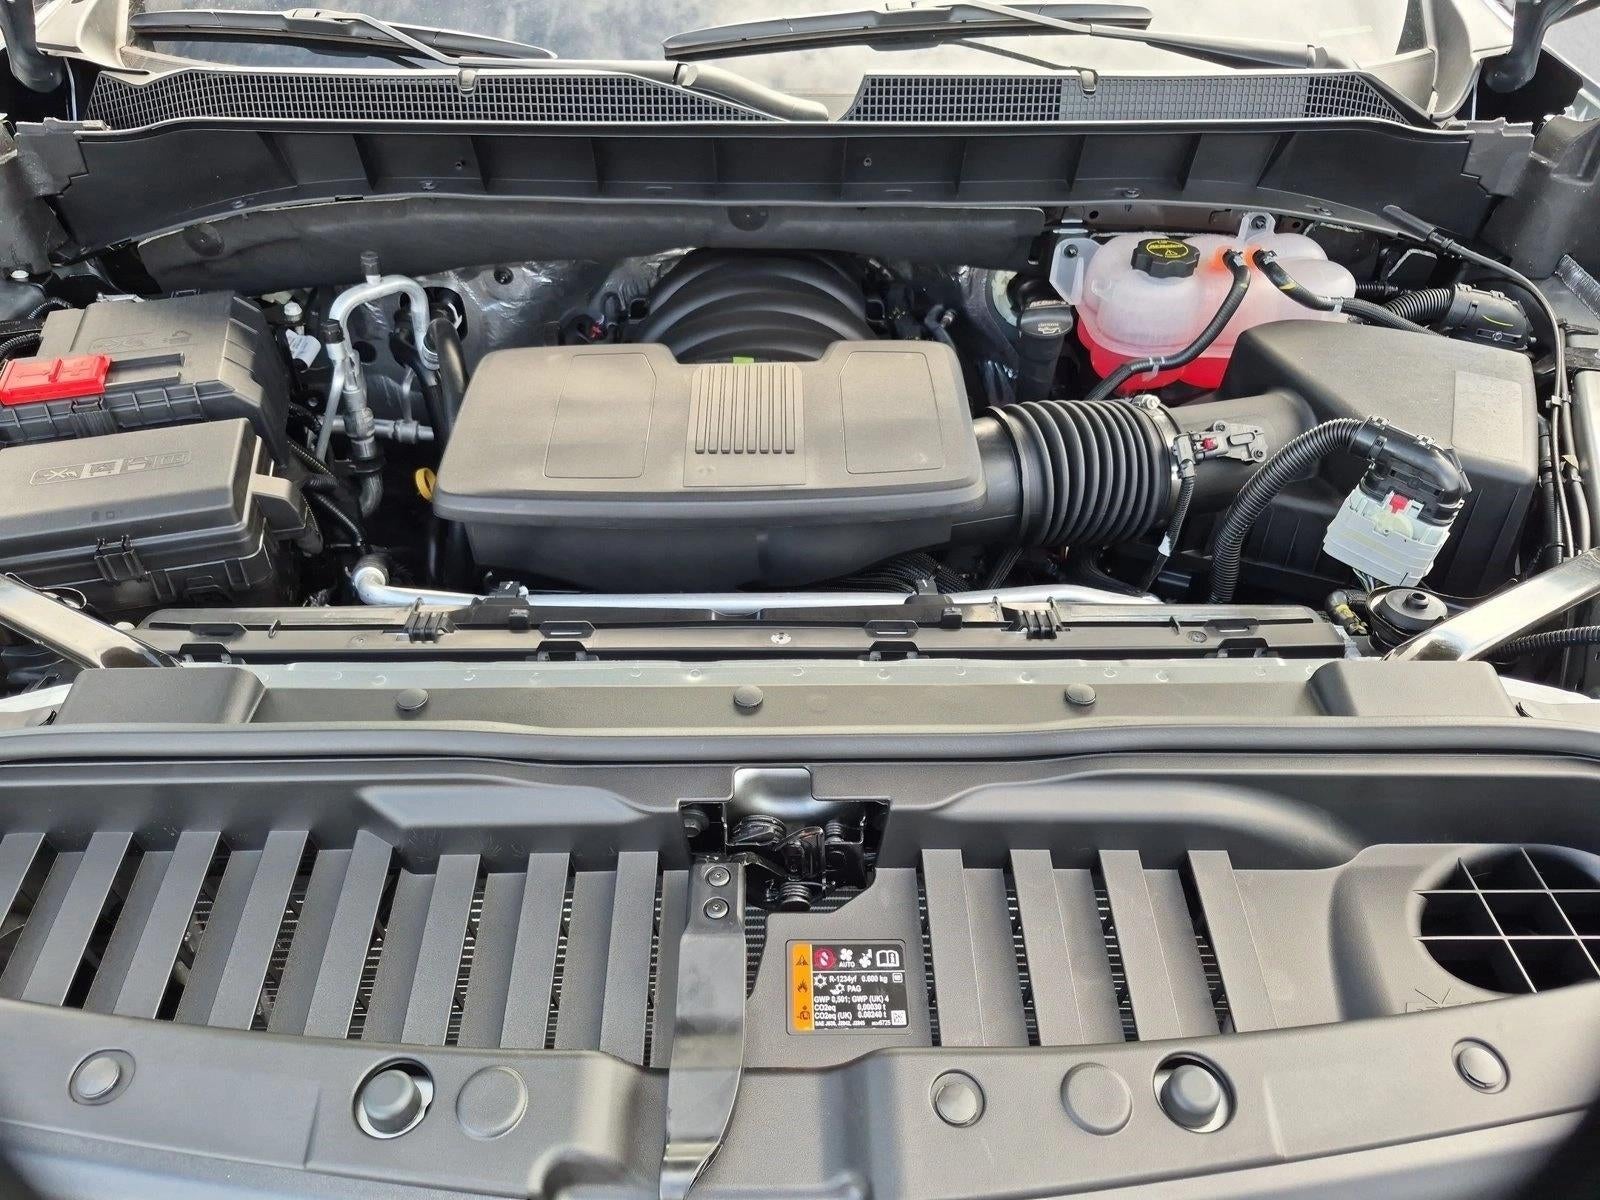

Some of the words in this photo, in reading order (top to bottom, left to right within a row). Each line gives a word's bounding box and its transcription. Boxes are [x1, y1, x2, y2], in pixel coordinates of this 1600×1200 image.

[829, 975, 857, 984] R-1234yf
[880, 975, 888, 984] kg
[814, 995, 830, 1003] GWP
[851, 995, 868, 1003] GWP
[869, 995, 884, 1004] (UK)
[814, 1004, 836, 1012] CO2eq
[814, 1012, 836, 1020] CO2eq
[837, 1011, 853, 1021] (UK)
